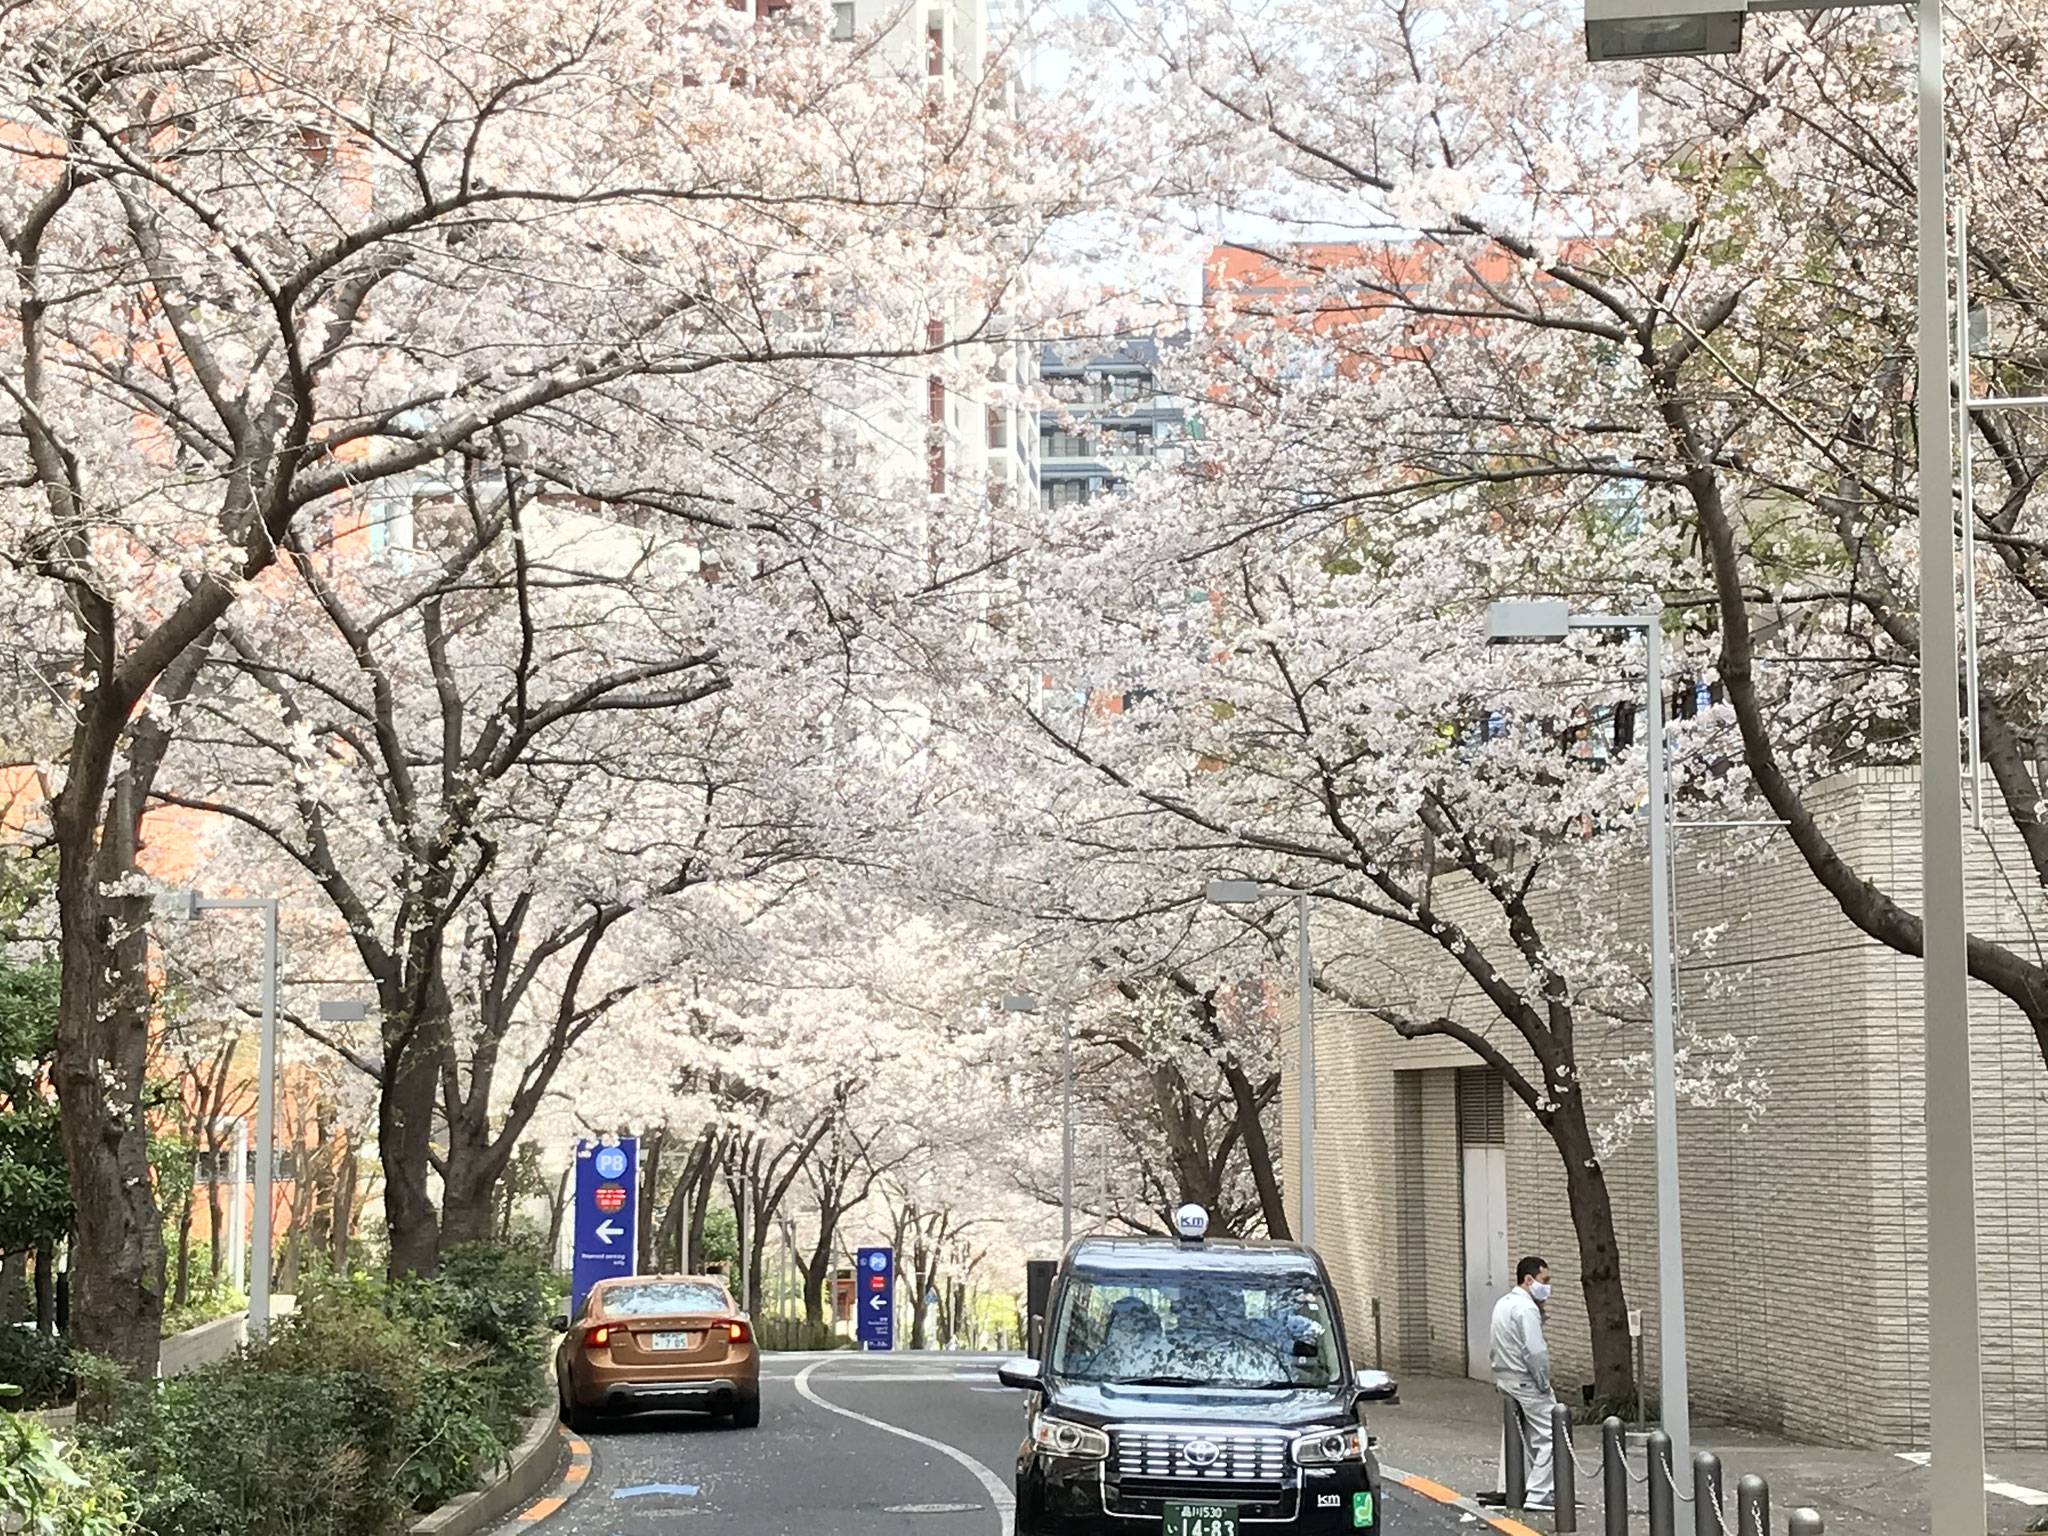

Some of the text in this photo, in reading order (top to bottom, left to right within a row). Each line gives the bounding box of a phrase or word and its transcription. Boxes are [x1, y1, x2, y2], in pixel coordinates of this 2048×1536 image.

[600, 1155, 624, 1171] P8
[1180, 1216, 1204, 1227] km
[1317, 1494, 1340, 1506] km
[1183, 1518, 1234, 1536] 14-83
